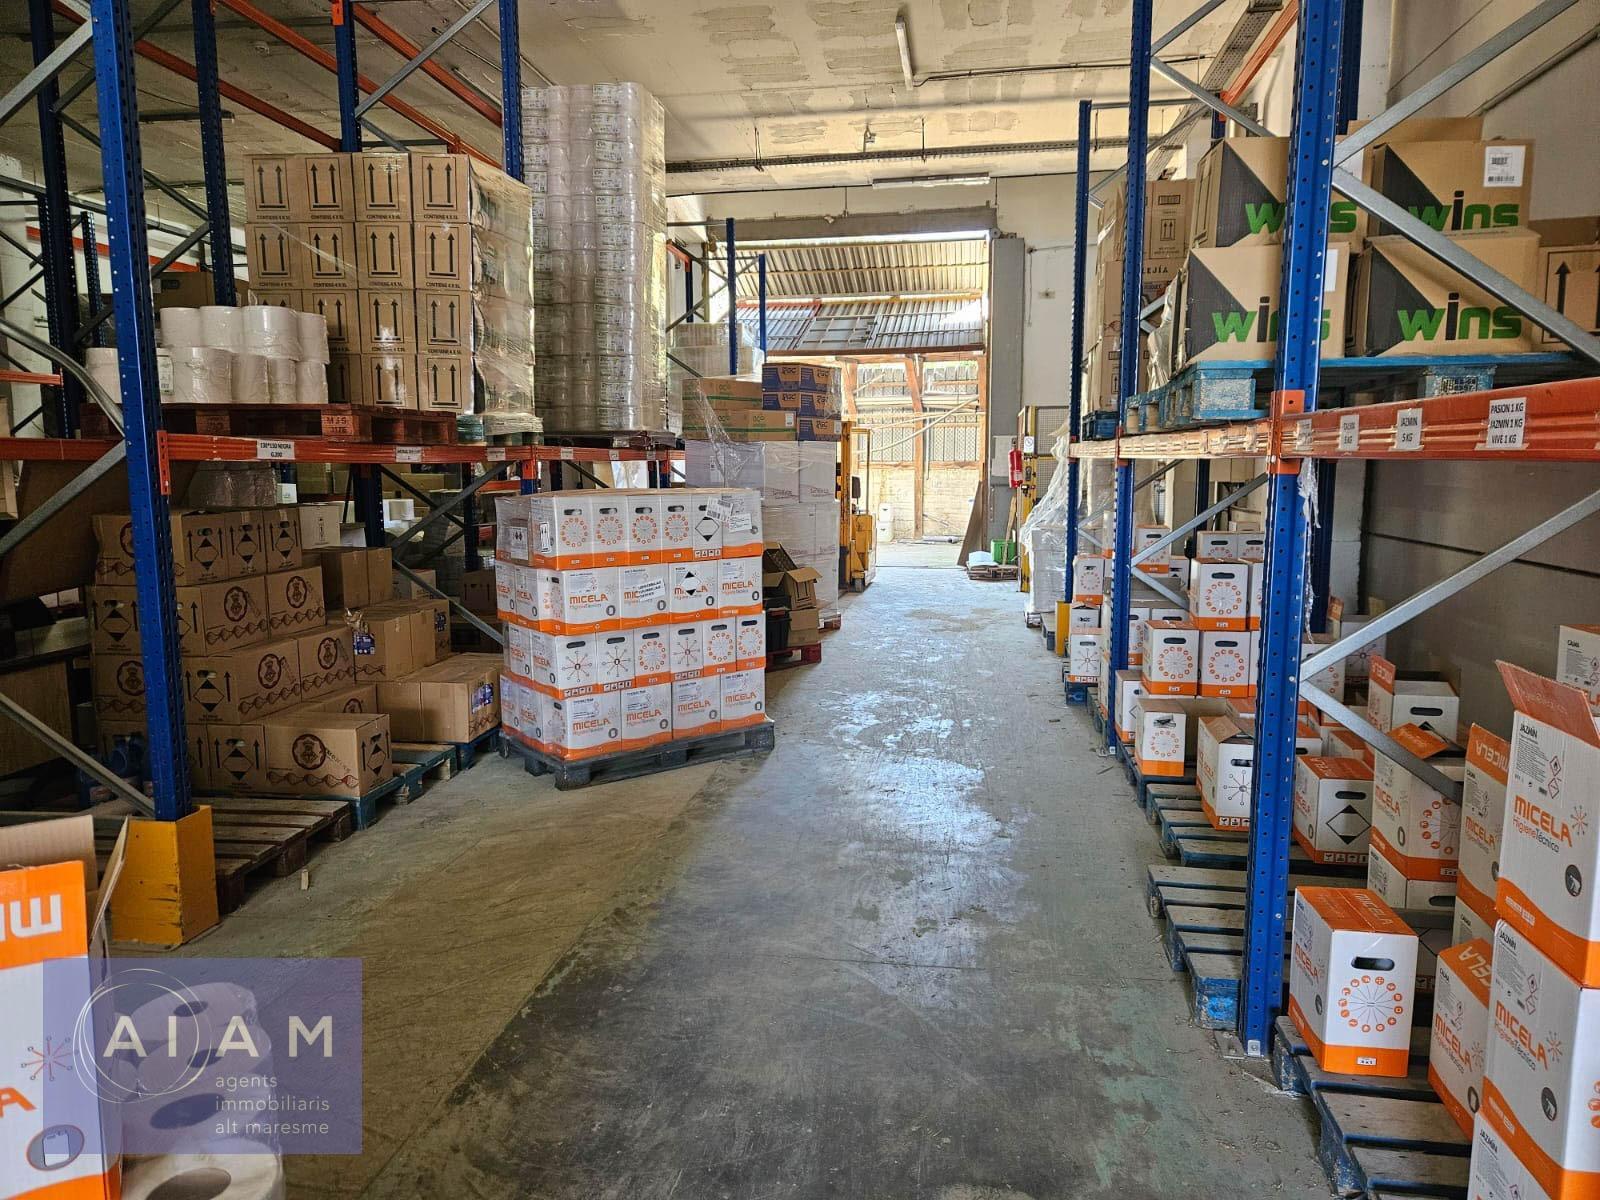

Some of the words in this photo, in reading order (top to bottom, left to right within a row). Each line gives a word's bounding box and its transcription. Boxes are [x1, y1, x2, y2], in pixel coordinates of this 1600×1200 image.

[1245, 200, 1357, 235] ws
[1398, 292, 1522, 341] wins
[1515, 403, 1524, 412] KG
[1514, 418, 1523, 428] KG
[1406, 433, 1413, 441] KG
[1492, 434, 1503, 444] VIVE
[1509, 434, 1517, 443] KG
[722, 580, 753, 591] MICELA
[569, 593, 608, 604] MICELA
[725, 691, 756, 703] MICELA
[678, 700, 711, 712] MICELA
[627, 709, 662, 721] MICELA
[572, 718, 611, 731] MICELA
[1513, 795, 1573, 848] MICELA
[1464, 816, 1495, 851] MICELA
[1354, 893, 1393, 926] MICELA
[1495, 1000, 1548, 1071] MICELA
[1435, 1012, 1473, 1072] MICELA
